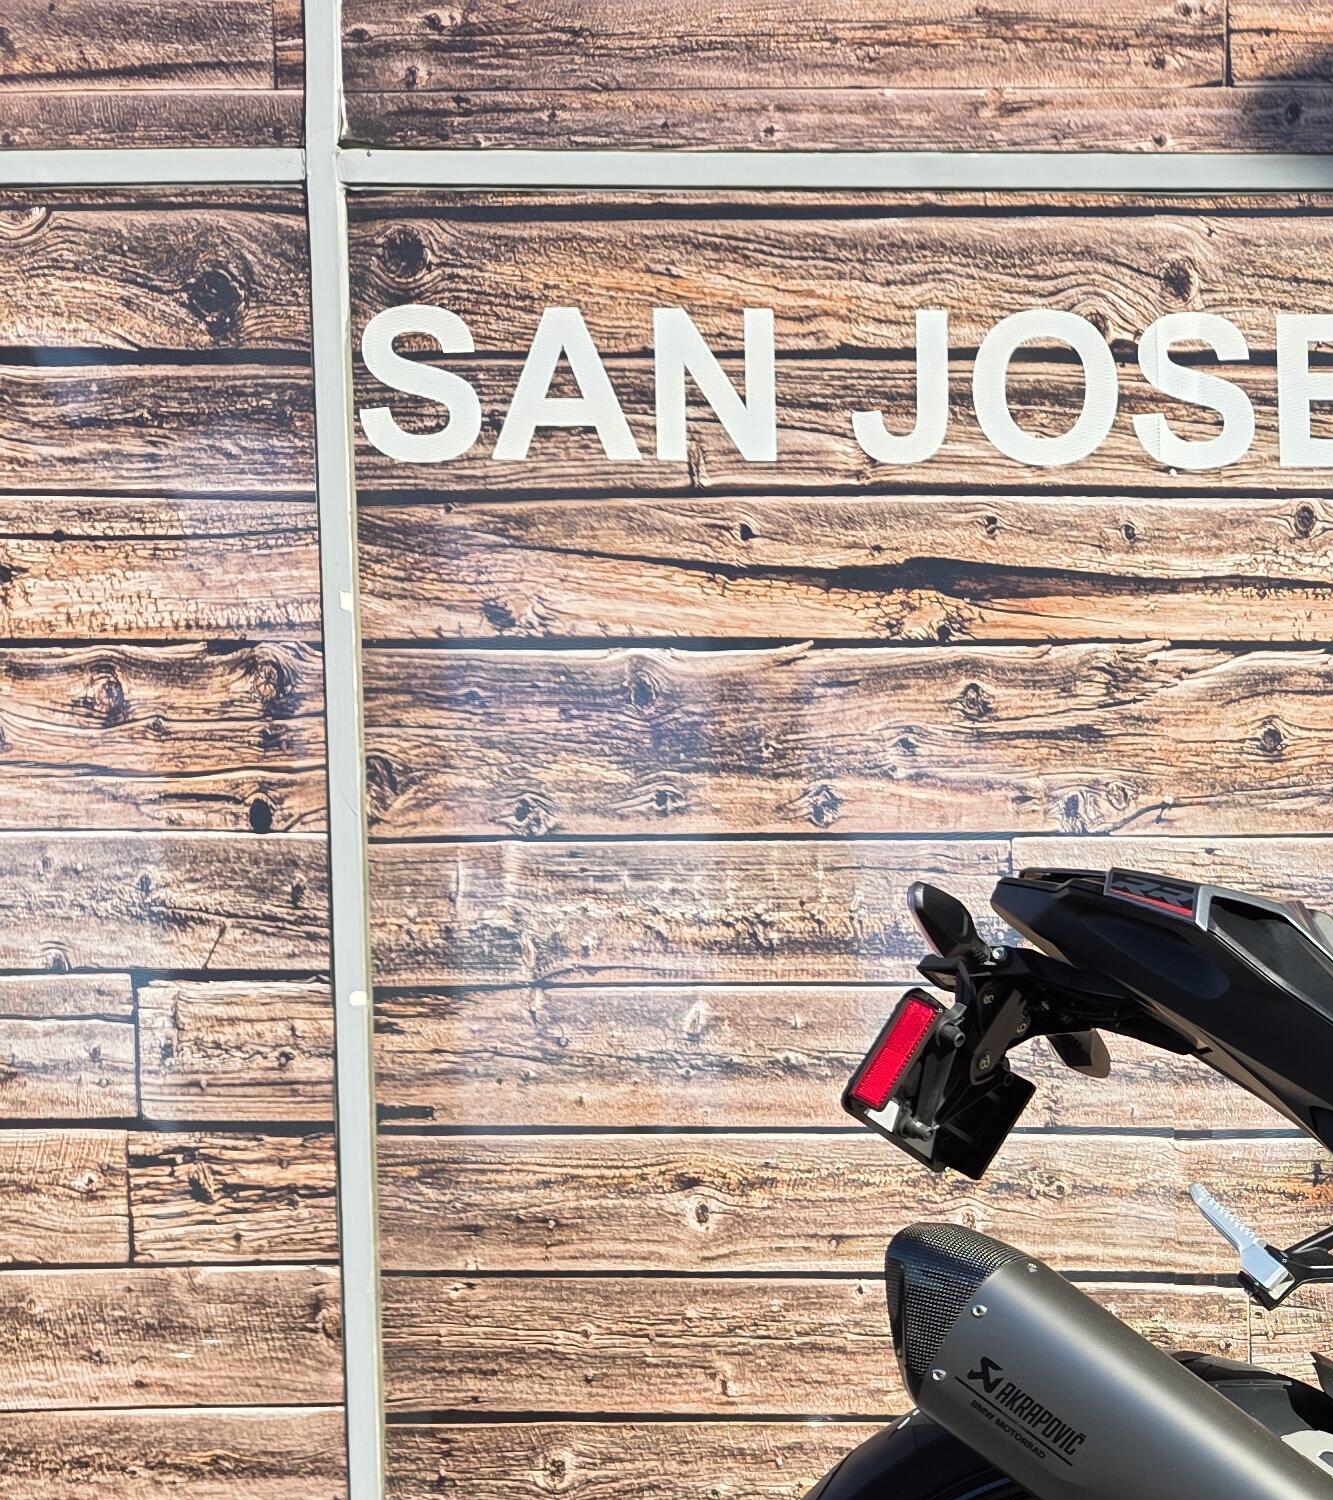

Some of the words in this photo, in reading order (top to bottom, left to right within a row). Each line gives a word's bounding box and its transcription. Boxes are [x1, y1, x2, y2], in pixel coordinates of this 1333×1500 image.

[360, 306, 778, 463] SAN
[1111, 876, 1193, 907] RR
[970, 1399, 996, 1421] BMW
[996, 1420, 1046, 1459] MOTORRAD
